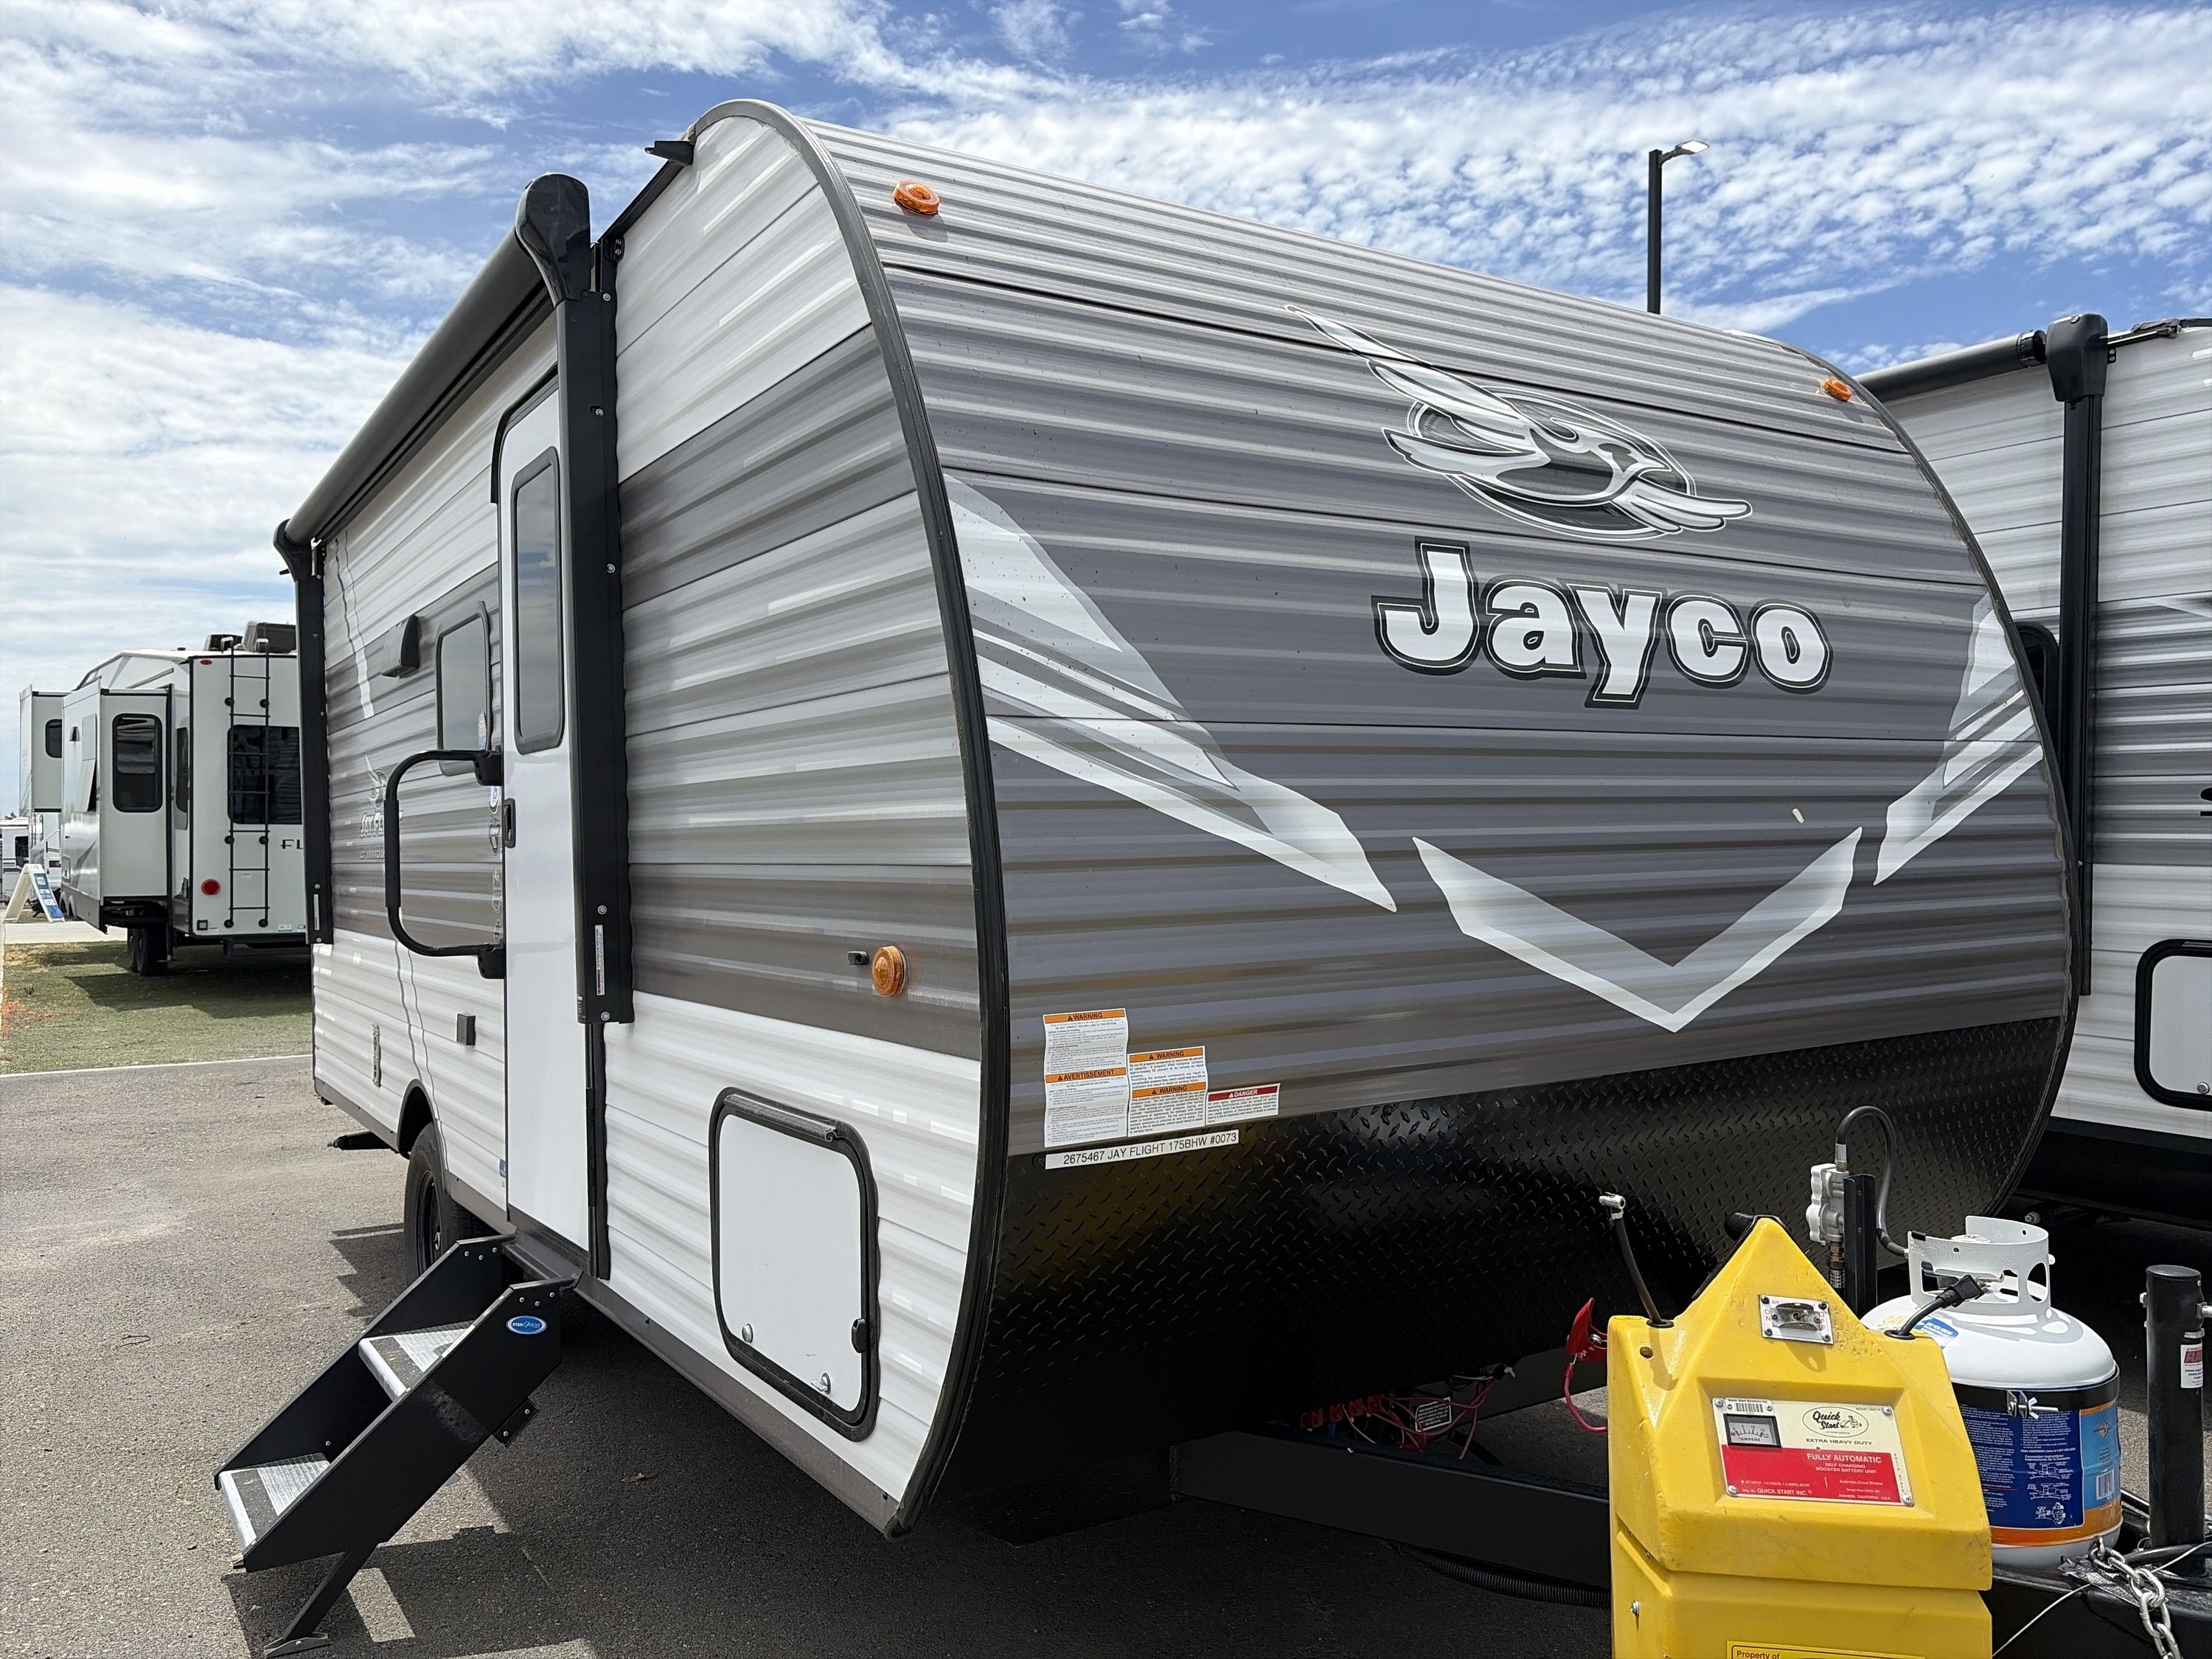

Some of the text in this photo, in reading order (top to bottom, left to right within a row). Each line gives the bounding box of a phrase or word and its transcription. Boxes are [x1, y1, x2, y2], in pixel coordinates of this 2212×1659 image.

[1373, 538, 1833, 709] Jayco
[1072, 1012, 1103, 1021] WARNING
[1156, 1051, 1185, 1059] WARNING
[1064, 1069, 1115, 1081] AVERTISSEMENT
[1159, 1085, 1187, 1094] WARNING
[1063, 1132, 1237, 1165] 2675467 JAY FLIGHT 175BHW #0073
[1765, 1309, 1771, 1321] ON
[1812, 1411, 1841, 1423] Quick
[1819, 1421, 1840, 1430] Start
[1834, 1454, 1882, 1464] AUTOMATIC
[1737, 1650, 1770, 1659] Property
